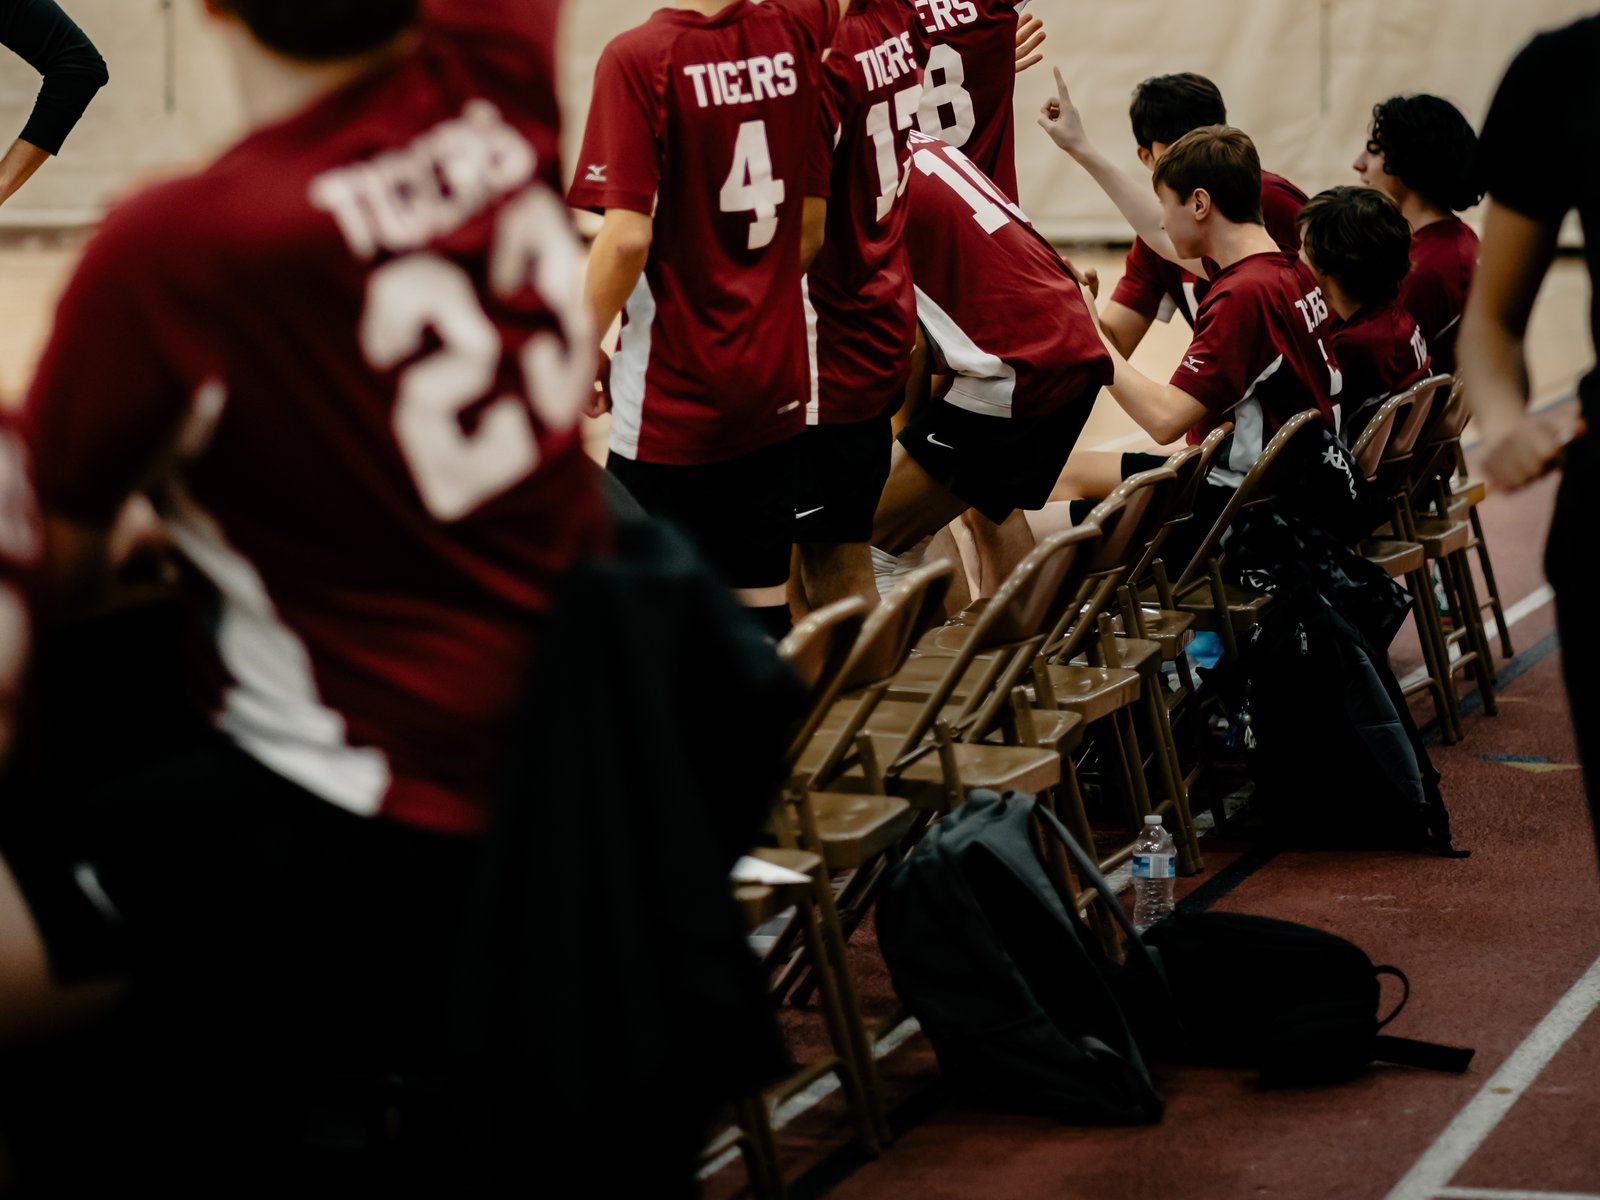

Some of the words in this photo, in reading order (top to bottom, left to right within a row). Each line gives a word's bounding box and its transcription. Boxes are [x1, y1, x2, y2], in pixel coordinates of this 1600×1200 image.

[683, 51, 798, 108] TIGERS
[719, 119, 786, 250] 4
[360, 184, 599, 524] 23
